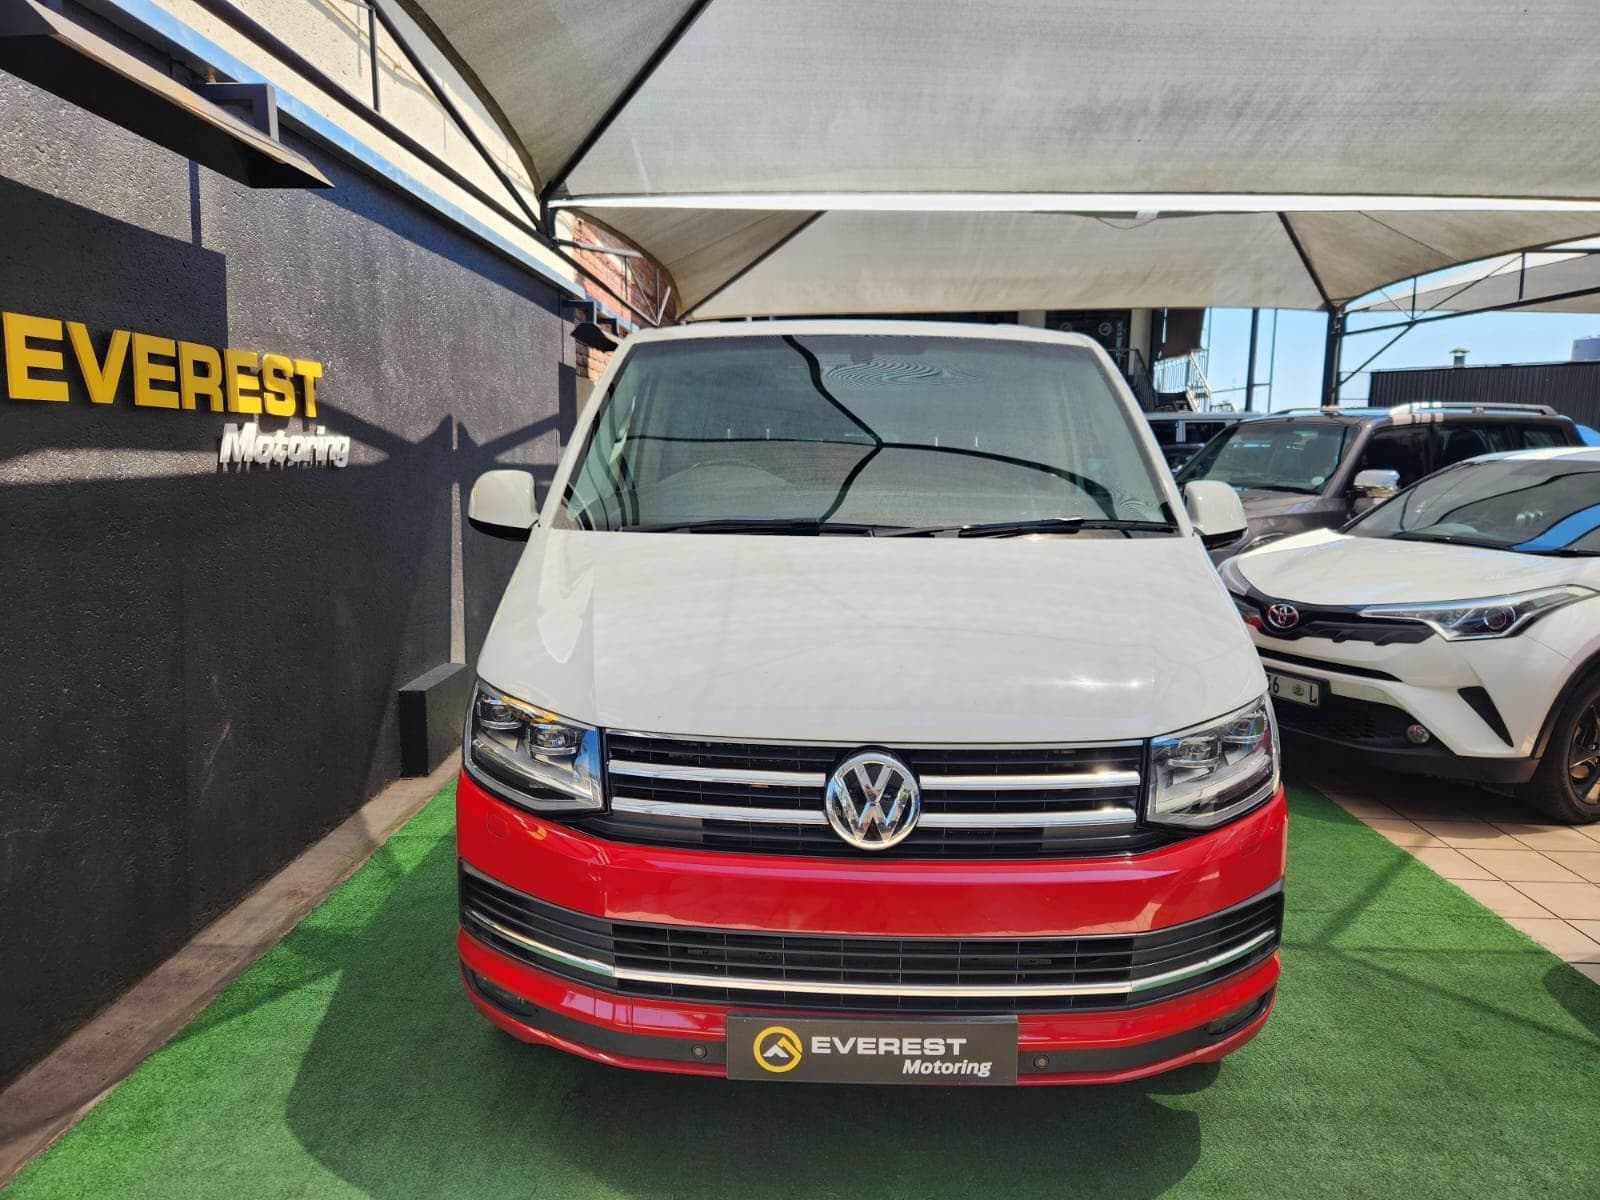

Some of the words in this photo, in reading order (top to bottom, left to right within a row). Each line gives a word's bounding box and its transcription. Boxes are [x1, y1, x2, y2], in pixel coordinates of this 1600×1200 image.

[2, 311, 323, 418] EVEREST
[219, 422, 350, 468] Motoring
[811, 1036, 966, 1056] EVEREST
[902, 1059, 992, 1078] Motoring
